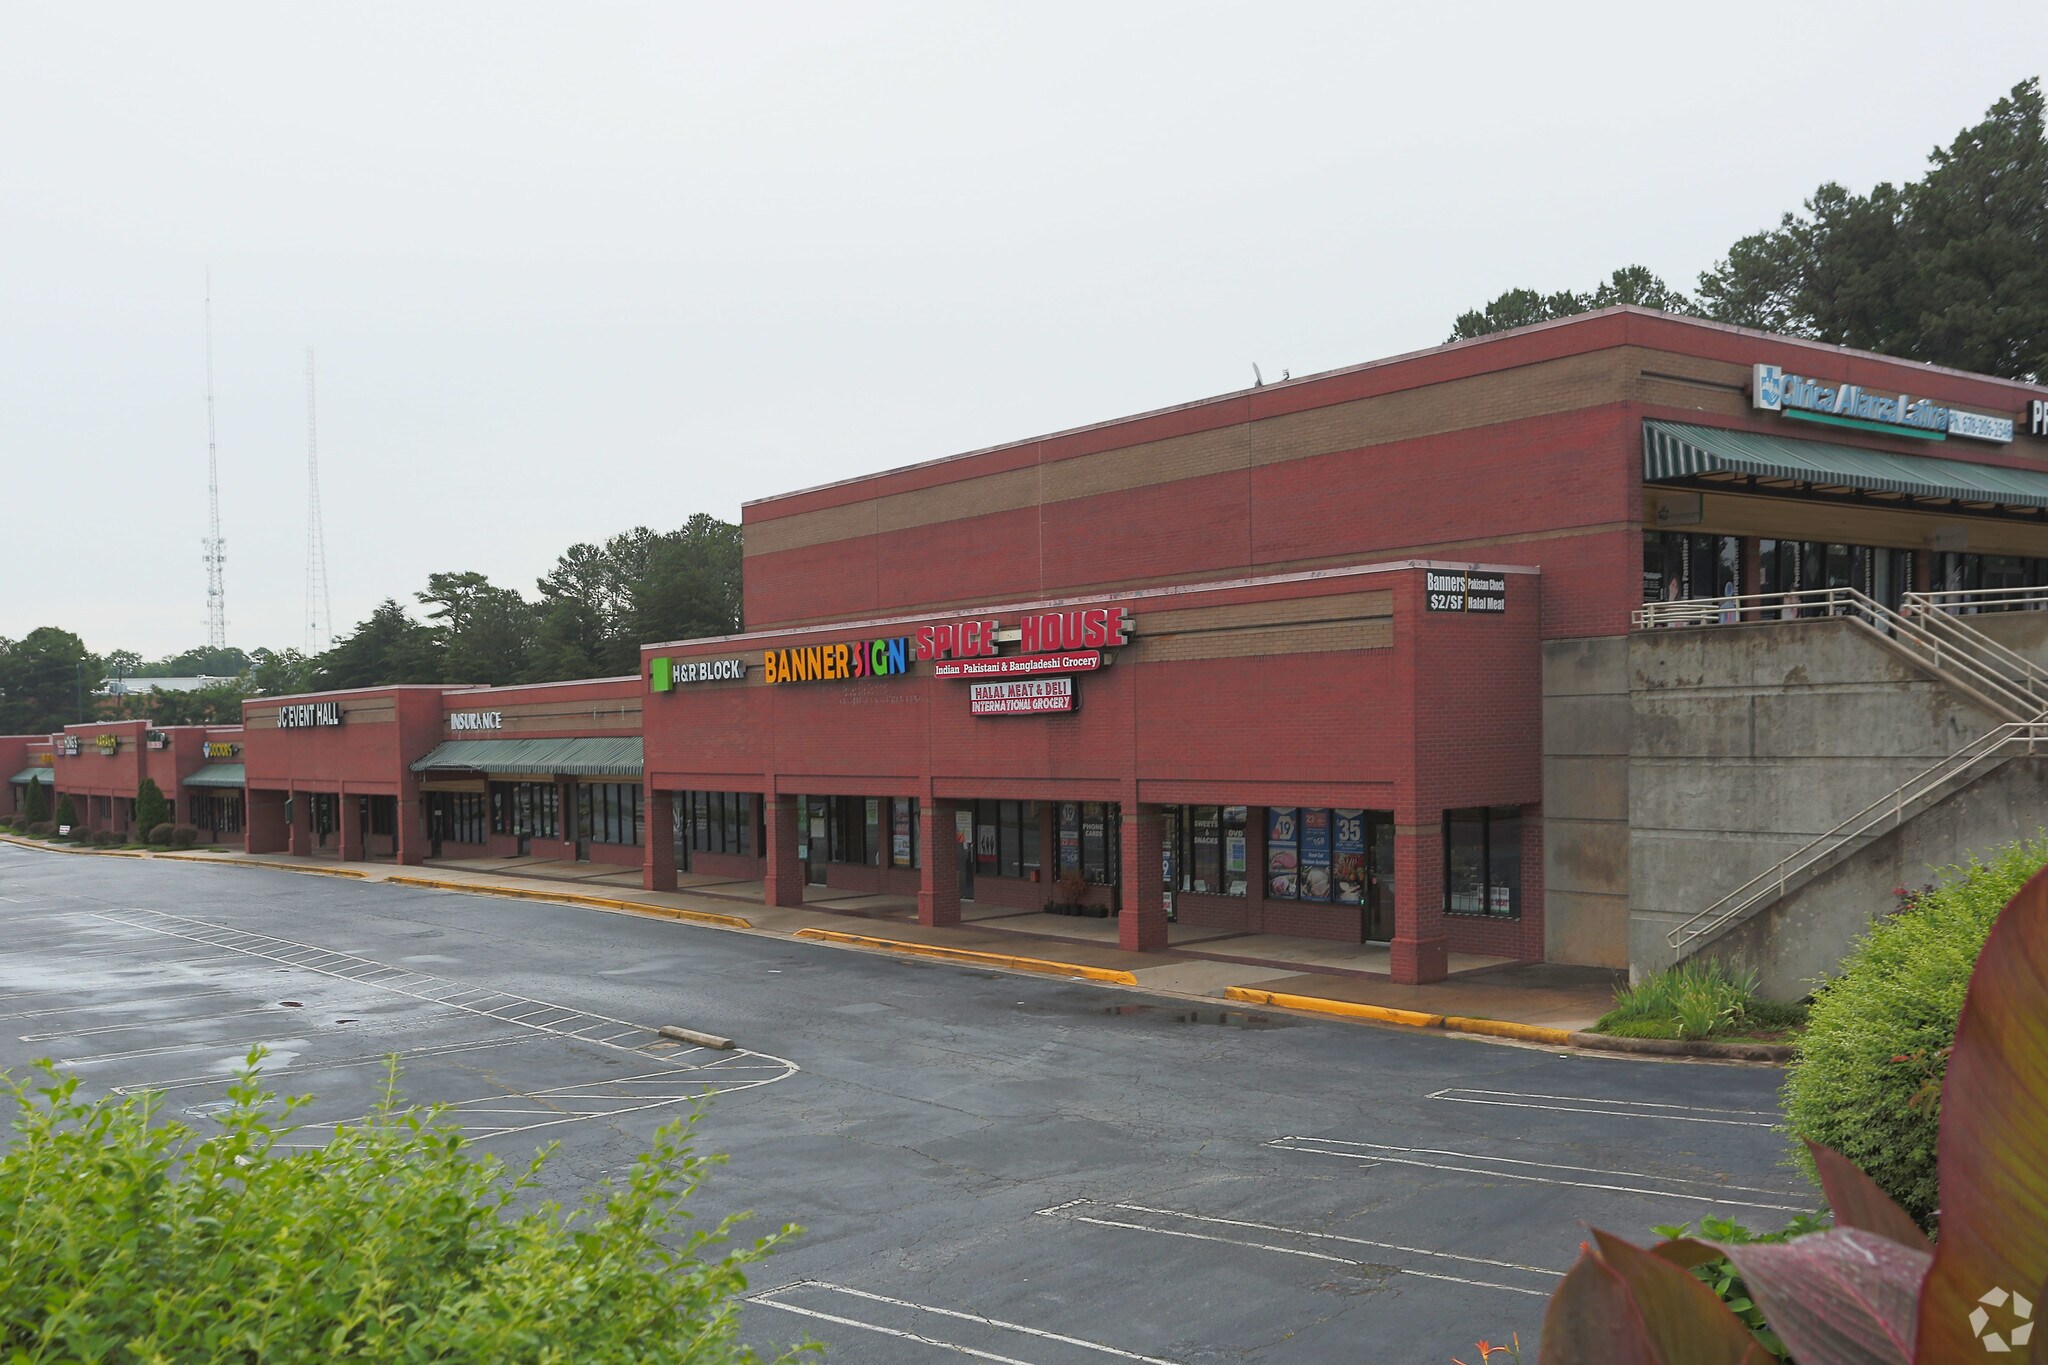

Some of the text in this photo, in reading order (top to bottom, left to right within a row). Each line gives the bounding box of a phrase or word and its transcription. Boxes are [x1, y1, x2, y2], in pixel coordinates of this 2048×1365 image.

[1834, 384, 1898, 422] Alianza
[1896, 395, 1949, 430] Latina
[1427, 572, 1466, 592] Banners
[1431, 594, 1463, 610] $2/SF
[1468, 597, 1505, 610] Halal Meat
[916, 608, 1124, 660] SPICE HOUSE
[764, 637, 906, 683] BANNER SIGN
[935, 656, 1097, 675] Indian Pakistani & Bangladeshi Grocery
[672, 660, 740, 683] H&R BLOCK
[975, 681, 1067, 700] HALAL MEAT & DELI
[972, 697, 1070, 713] INTERNATIONAL GROCERY
[277, 702, 338, 728] JC EVENT HALL
[450, 711, 502, 730] INSURANCE
[1193, 820, 1218, 828] SWEETS
[1228, 829, 1244, 837] DVD
[1279, 821, 1291, 835] 19
